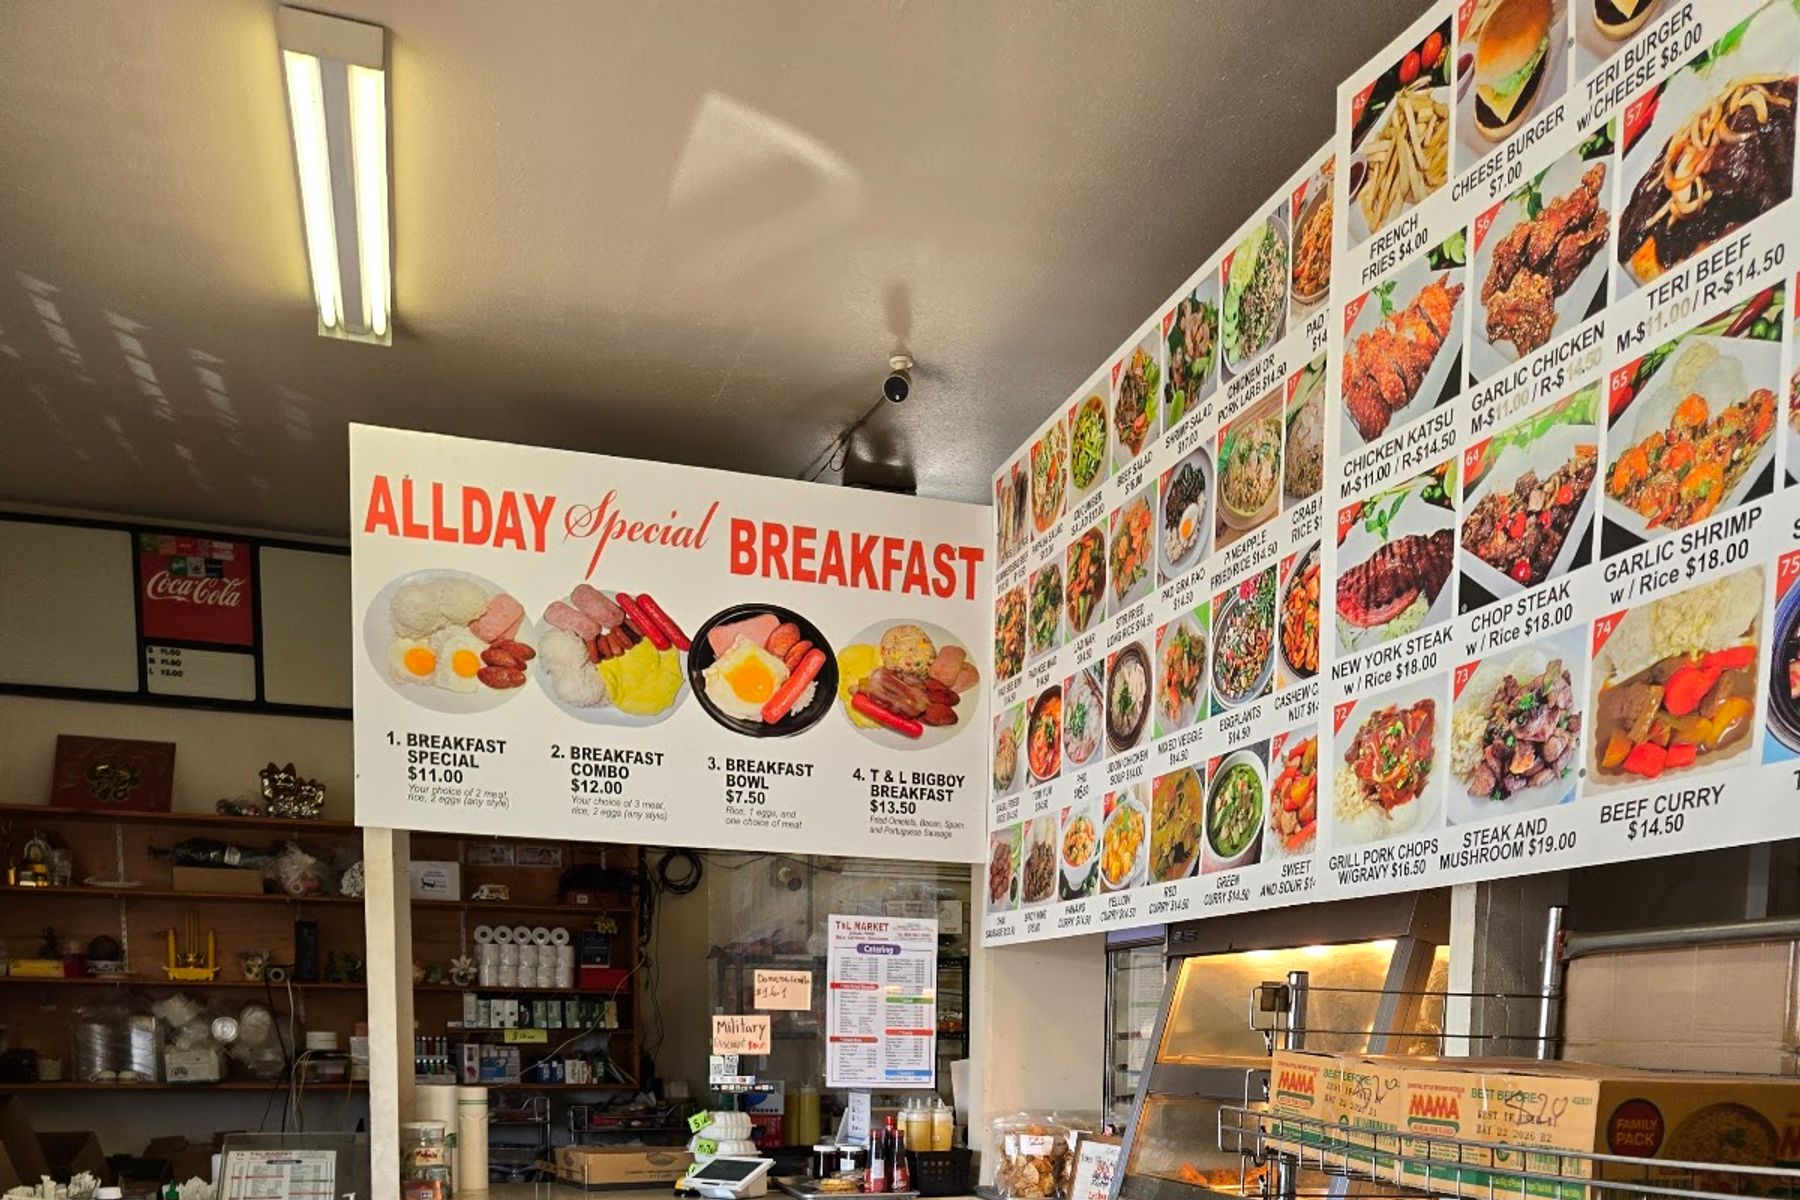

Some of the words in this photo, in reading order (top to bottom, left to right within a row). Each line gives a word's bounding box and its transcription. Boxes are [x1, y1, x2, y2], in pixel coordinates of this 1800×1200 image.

[1587, 60, 1620, 101] TERI
[1624, 3, 1694, 73] BURGER
[1661, 23, 1702, 69] $8.00
[1626, 103, 1643, 126] 57
[1452, 152, 1503, 202] CHEESE
[1507, 105, 1565, 158] BURGER
[1490, 162, 1522, 198] $7.00
[1370, 213, 1419, 259] FRENCH
[1477, 219, 1490, 236] 56
[1362, 250, 1395, 285] FRIES
[1399, 228, 1428, 262] $4.00
[1647, 271, 1689, 312] TERI
[1696, 233, 1752, 283] BEEF
[1703, 243, 1785, 305] R-$14.50
[1345, 303, 1359, 318] 55
[1471, 367, 1529, 411] GARLIC
[1532, 320, 1605, 377] CHICKEN
[1612, 374, 1629, 391] 65
[1344, 434, 1404, 477] CHICKEN
[1407, 408, 1454, 449] KATSU
[1341, 462, 1391, 499] M-$11.00
[1402, 430, 1456, 470] R-$14.50
[1466, 451, 1479, 466] 64
[1291, 501, 1317, 525] CRAB
[1340, 510, 1351, 524] 63
[364, 475, 557, 553] ALLDAY
[562, 489, 720, 580] Special
[729, 517, 985, 600] BREAKFAST
[1291, 520, 1312, 543] RICE
[1604, 540, 1674, 583] GARLIC
[1680, 507, 1762, 554] SHRIMP
[1640, 565, 1680, 595] Rice
[1686, 538, 1749, 580] $18.00
[147, 570, 247, 607] Coca-Cola
[1471, 603, 1513, 633] CHOP
[1517, 580, 1570, 616] STEAK
[1489, 626, 1520, 649] Rice
[1524, 602, 1573, 637] $18.00
[1596, 621, 1611, 639] 74
[1331, 656, 1361, 680] NEW
[1364, 644, 1403, 670] YORK
[1406, 625, 1453, 656] STEAK
[1365, 668, 1392, 690] Rice
[1396, 652, 1437, 680] $18.00
[1456, 669, 1469, 684] 73
[1335, 706, 1347, 722] 72
[386, 731, 401, 746] 1.
[406, 733, 507, 754] BREAKFAST
[407, 749, 480, 768] SPECIAL
[551, 744, 565, 759] 2.
[570, 746, 664, 766] BREAKFAST
[707, 756, 721, 771] 3.
[726, 758, 814, 777] BREAKFAST
[407, 765, 463, 783] $11.00
[571, 762, 629, 779] COMBO
[726, 774, 769, 790] BOWL
[852, 768, 865, 781] 4.
[870, 769, 879, 782] T
[884, 770, 894, 783] &
[899, 771, 907, 784] L
[912, 772, 965, 788] BIGBOY
[408, 784, 429, 794] Your
[571, 778, 623, 795] $12.00
[725, 789, 765, 805] $7.50
[871, 785, 954, 802] BREAKFAST
[870, 799, 916, 814] $13.50
[1600, 798, 1649, 824] BEEF
[1654, 783, 1726, 815] CURRY
[1463, 823, 1512, 849] STEAK
[1514, 817, 1548, 838] AND
[1627, 813, 1684, 840] $14.50
[1329, 851, 1360, 871] GRILL
[1364, 845, 1395, 866] PORK
[1397, 838, 1439, 858] CHOPS
[1439, 842, 1524, 870] MUSHROOM
[1528, 831, 1576, 857] $19.00
[1281, 860, 1312, 877] SWEET
[1392, 859, 1426, 879] $16.50
[1279, 879, 1302, 895] SOUR
[854, 921, 889, 931] MARKET
[863, 945, 894, 954] Catering
[717, 1018, 766, 1040] Military
[1278, 1071, 1315, 1095] MAMA
[1409, 1094, 1460, 1120] MAMA
[1616, 1118, 1658, 1131] FAMILY
[1616, 1132, 1655, 1146] PACK
